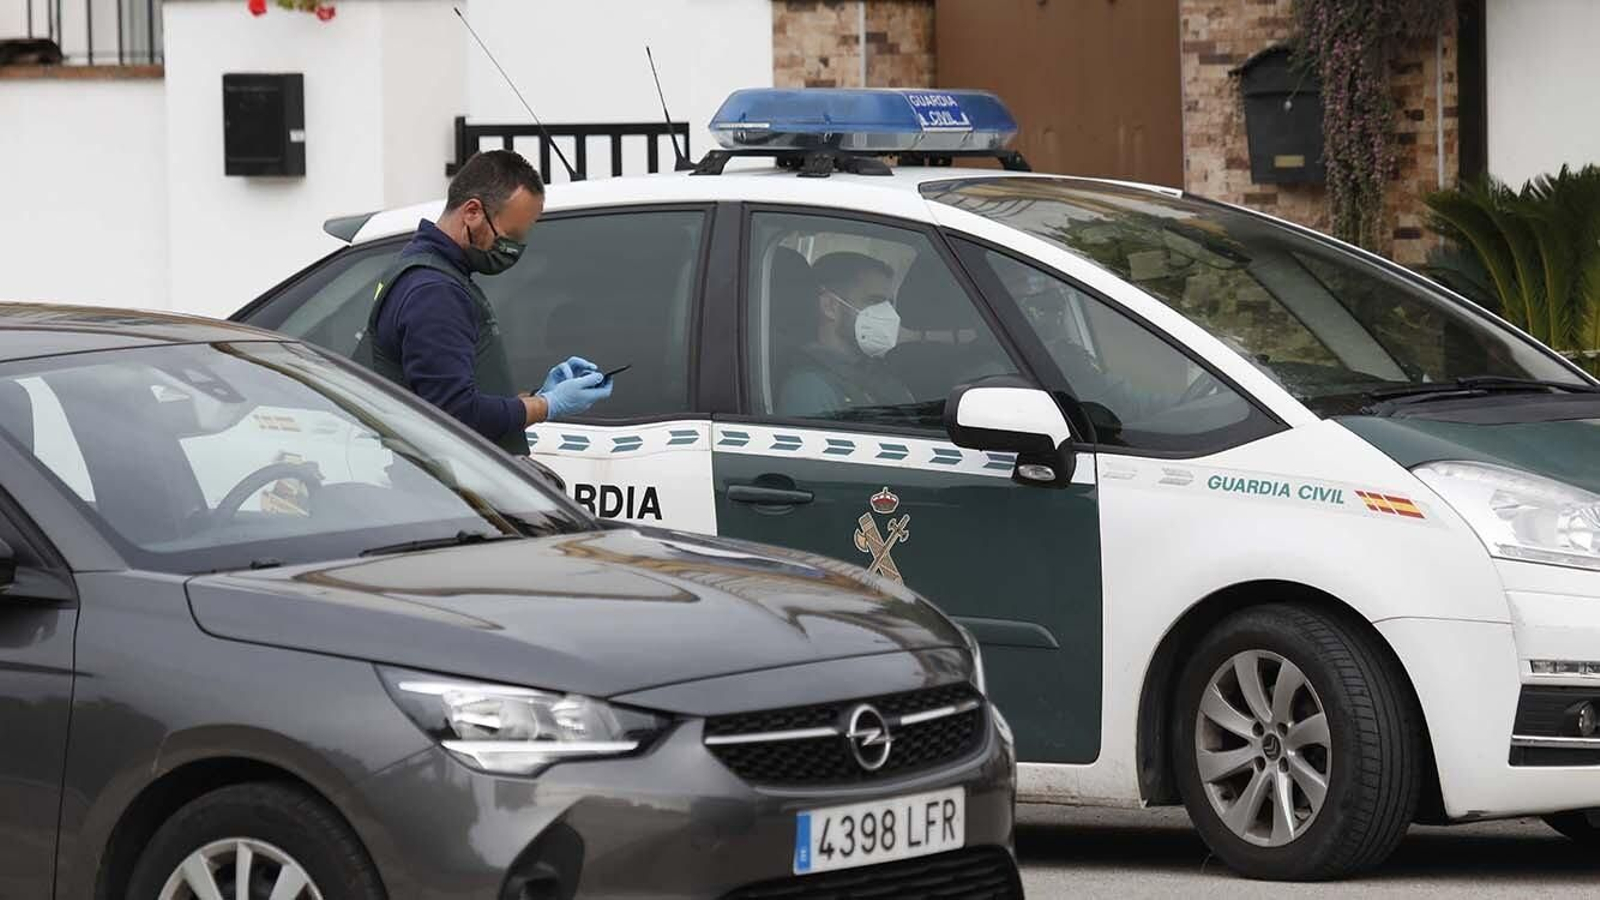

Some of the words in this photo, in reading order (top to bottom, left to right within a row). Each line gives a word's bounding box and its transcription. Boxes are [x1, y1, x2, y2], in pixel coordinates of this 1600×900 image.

[909, 95, 958, 107] GUARDIA
[928, 110, 956, 126] CIVIL
[574, 483, 663, 521] RDIA
[1207, 475, 1291, 498] GUARDIA
[1297, 484, 1345, 505] CIVIL
[818, 808, 896, 861] 4398
[907, 798, 957, 848] LFR
